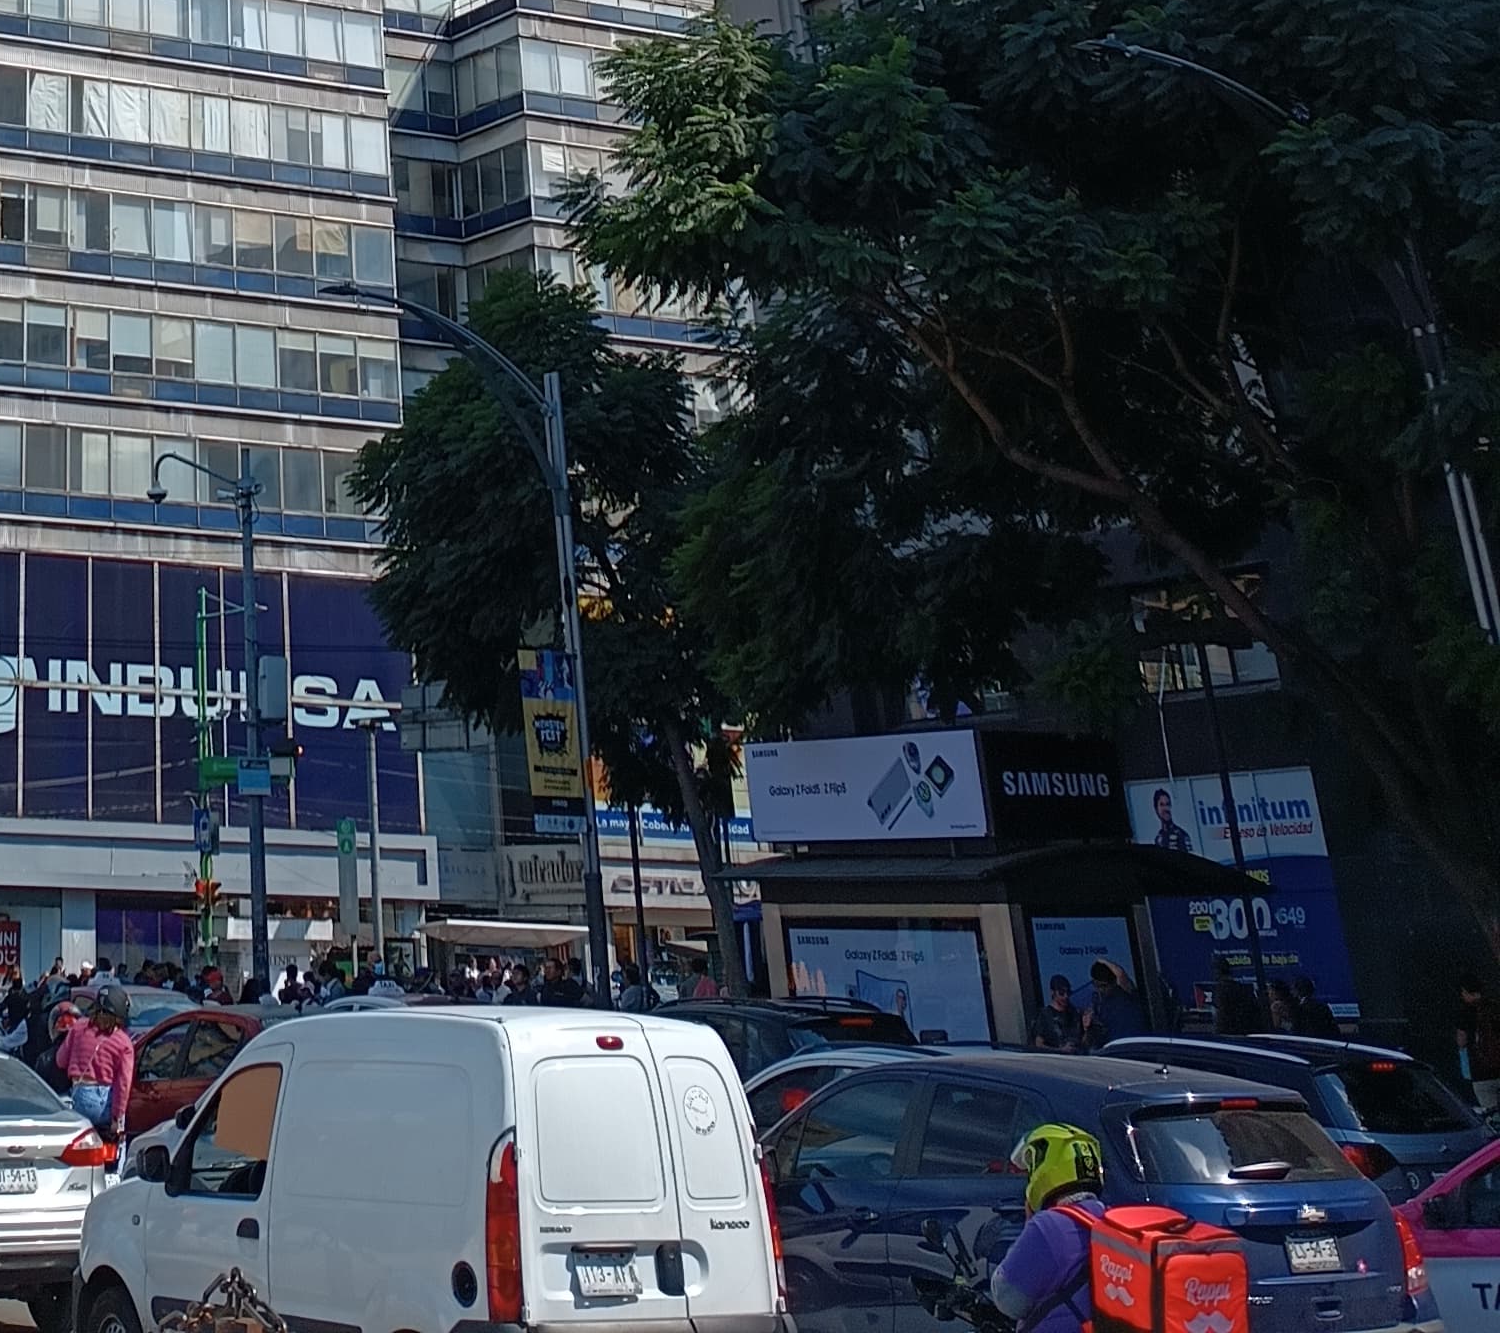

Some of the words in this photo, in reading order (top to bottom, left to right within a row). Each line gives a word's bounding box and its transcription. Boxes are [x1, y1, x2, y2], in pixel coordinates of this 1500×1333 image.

[769, 785, 795, 798] Galaxy
[1002, 770, 1110, 798] SAMSUNG
[1198, 797, 1311, 826] innitum
[845, 950, 872, 963] Galaxy
[1100, 1254, 1134, 1283] Rappi
[1184, 1277, 1232, 1307] Rappi
